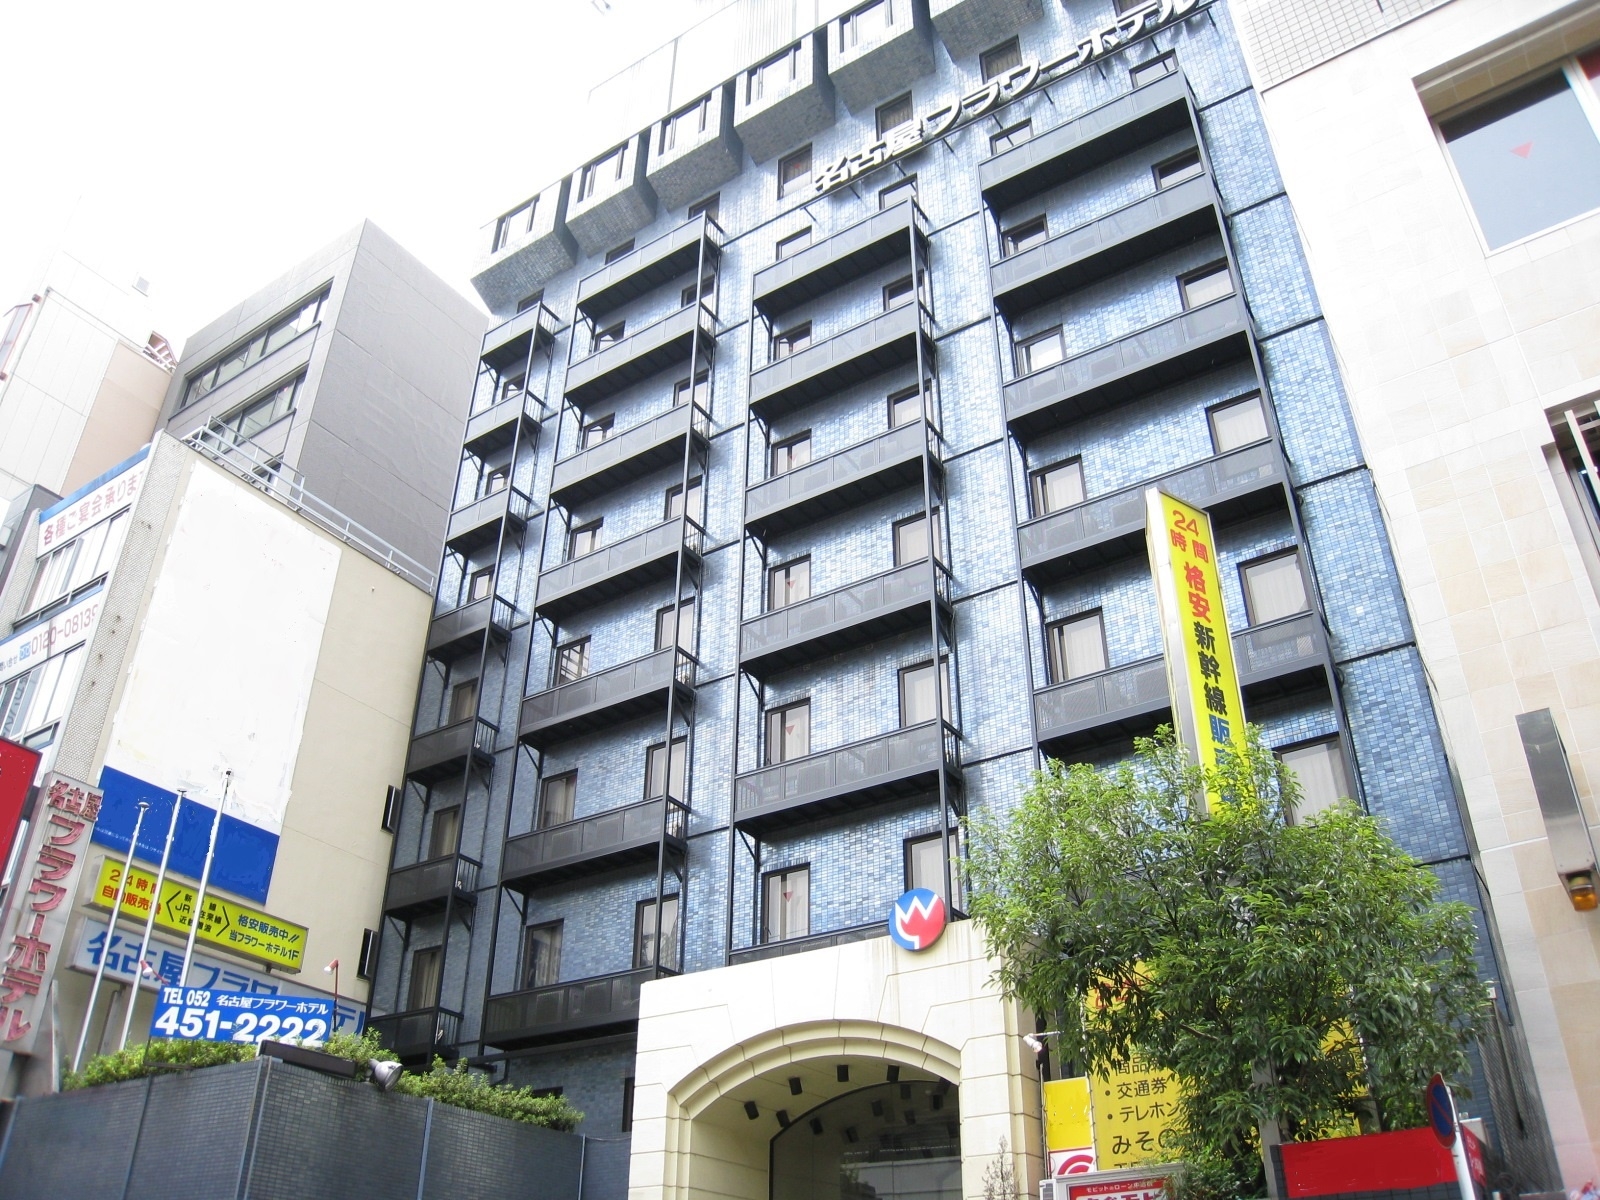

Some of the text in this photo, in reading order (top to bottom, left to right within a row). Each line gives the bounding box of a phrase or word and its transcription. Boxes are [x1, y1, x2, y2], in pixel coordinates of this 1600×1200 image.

[814, 0, 1200, 193] 名古屋フラワーホテル
[43, 470, 144, 546] 各種ご宴会承りま
[1173, 509, 1199, 537] 24
[1170, 529, 1209, 564] 時間
[48, 779, 103, 822] 名古屋
[0, 813, 86, 1042] フラワーホテル
[229, 929, 300, 961] 当フラワーホテル1F
[163, 987, 211, 1007] TEL 052
[216, 994, 329, 1015] 名古屋フラワーホテル
[154, 1006, 328, 1047] 451-2222
[1116, 1076, 1167, 1100] 交通券
